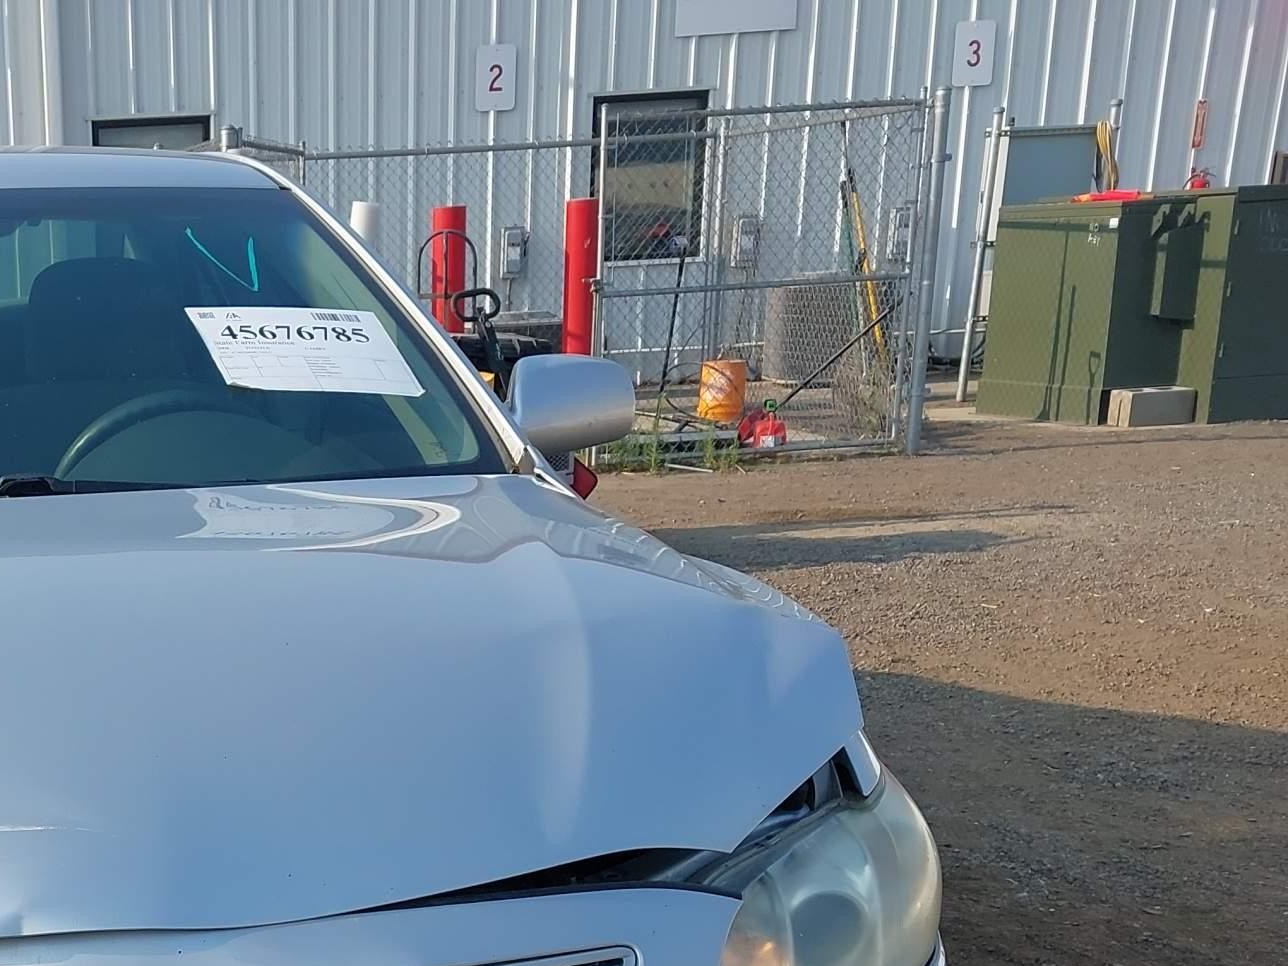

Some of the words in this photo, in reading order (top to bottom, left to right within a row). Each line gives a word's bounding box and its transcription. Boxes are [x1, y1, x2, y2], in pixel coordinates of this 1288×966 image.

[967, 40, 981, 67] 3
[489, 64, 503, 92] 2
[221, 324, 370, 343] 45676785
